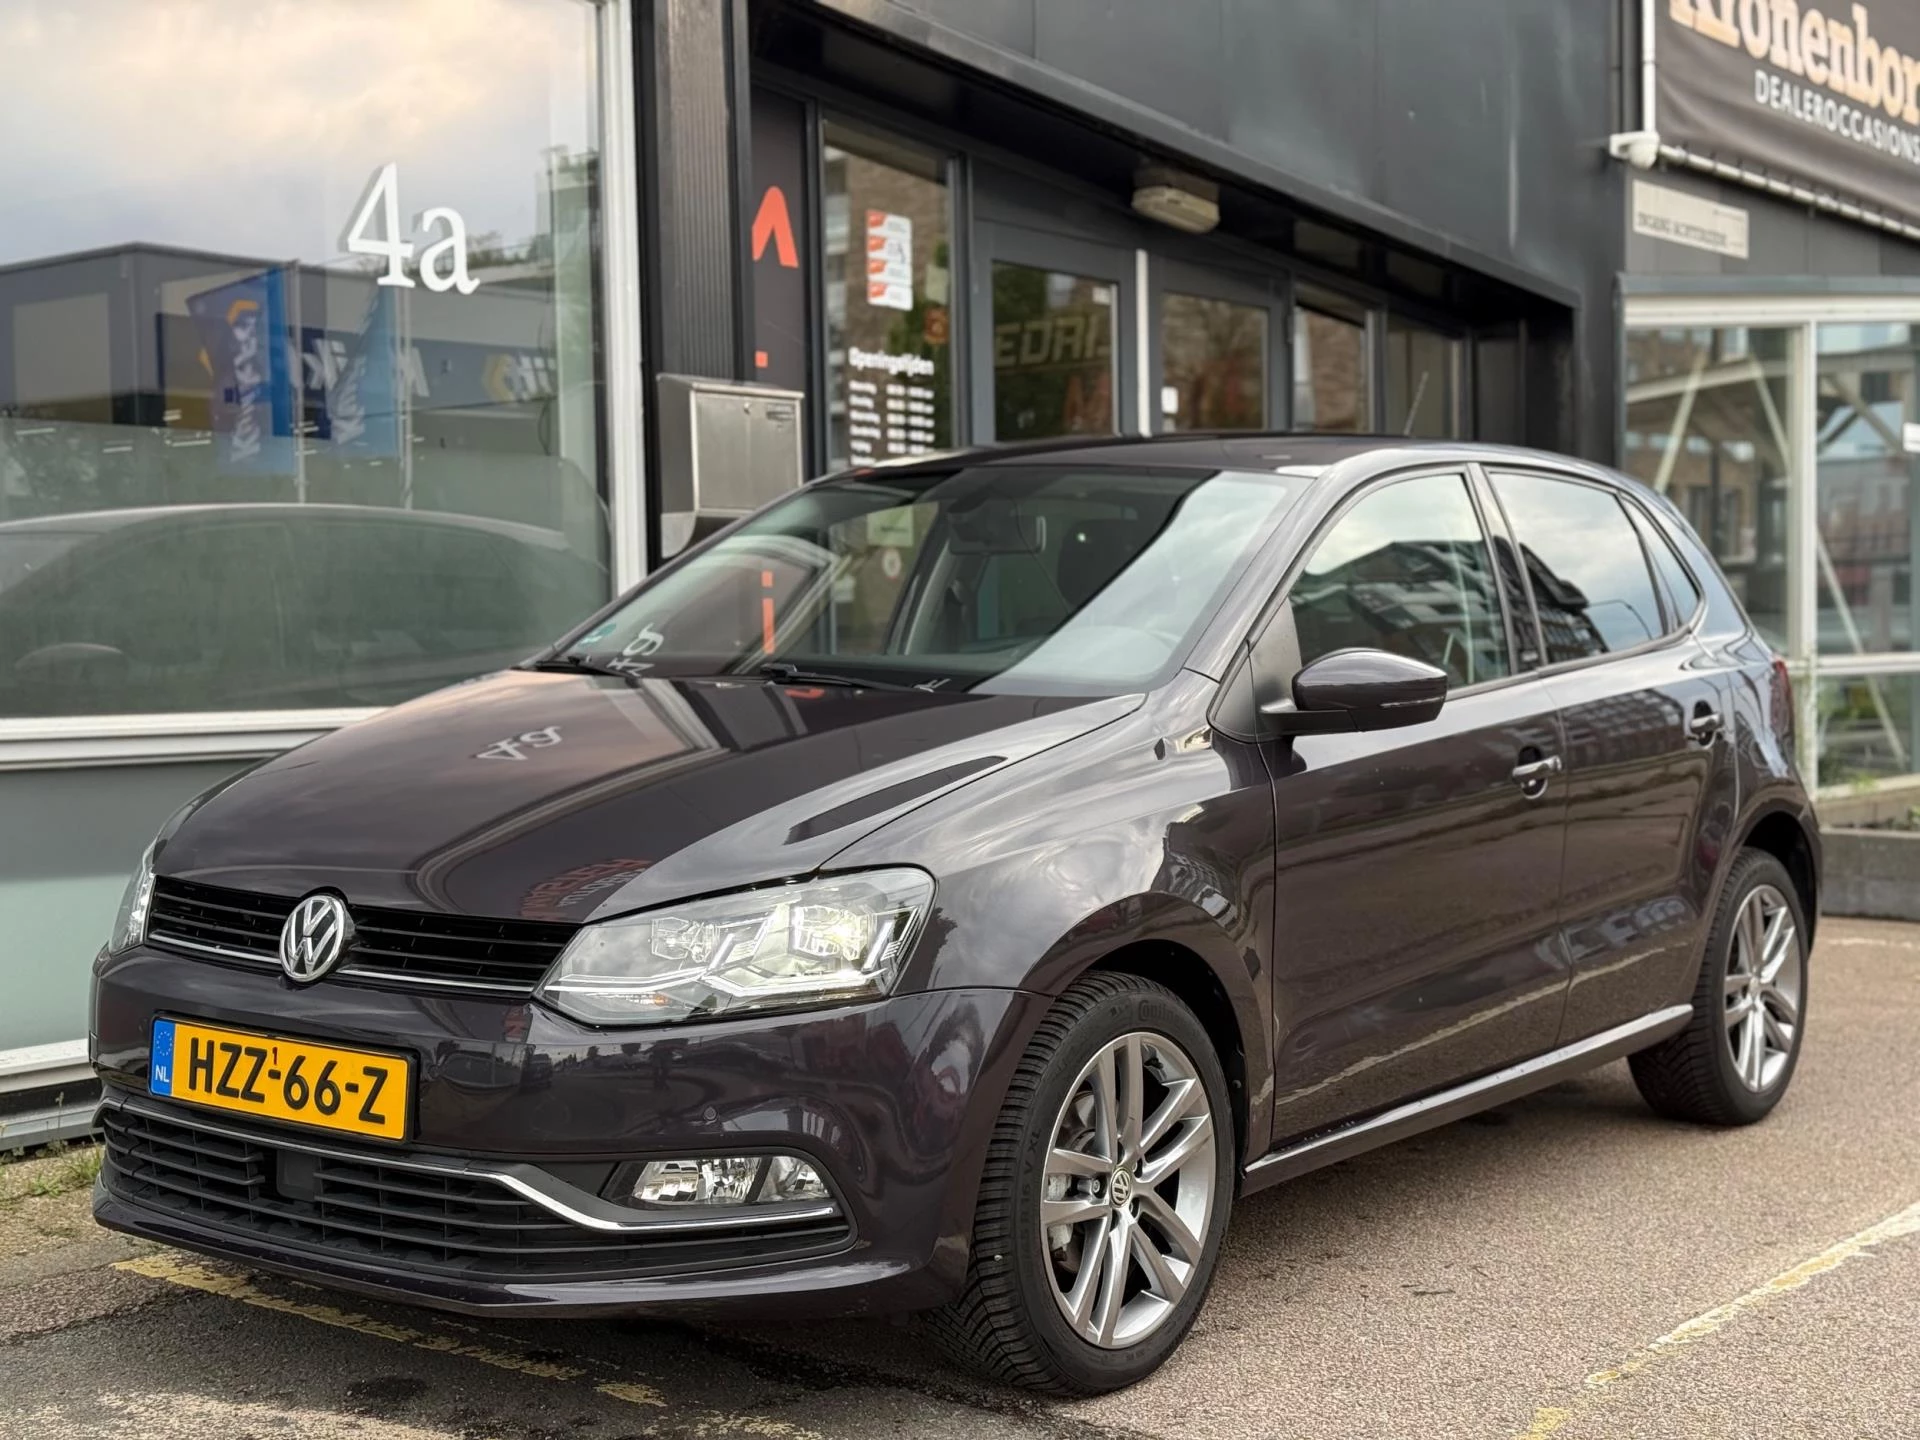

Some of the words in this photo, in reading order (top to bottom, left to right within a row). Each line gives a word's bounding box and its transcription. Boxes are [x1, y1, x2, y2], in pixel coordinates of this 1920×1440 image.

[347, 161, 480, 295] 4a
[155, 1064, 170, 1083] NL
[188, 1037, 388, 1125] HZZ-66-Z
